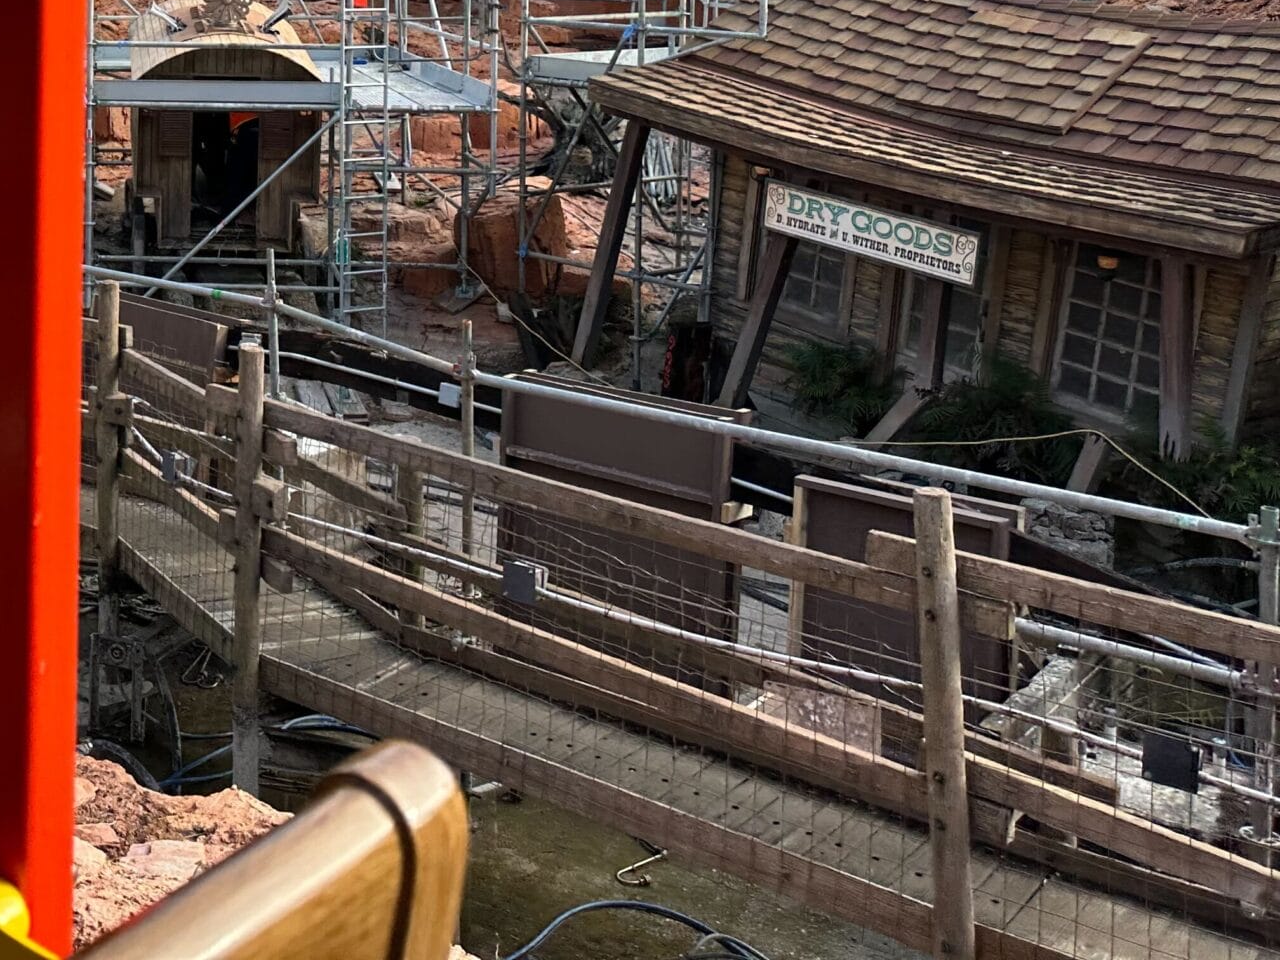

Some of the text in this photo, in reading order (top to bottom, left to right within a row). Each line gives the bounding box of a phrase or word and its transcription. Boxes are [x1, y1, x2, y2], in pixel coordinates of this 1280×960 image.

[786, 216, 826, 236] HYDRATE
[893, 246, 961, 275] PROPRIETORS
[787, 192, 955, 256] DRY GOODS
